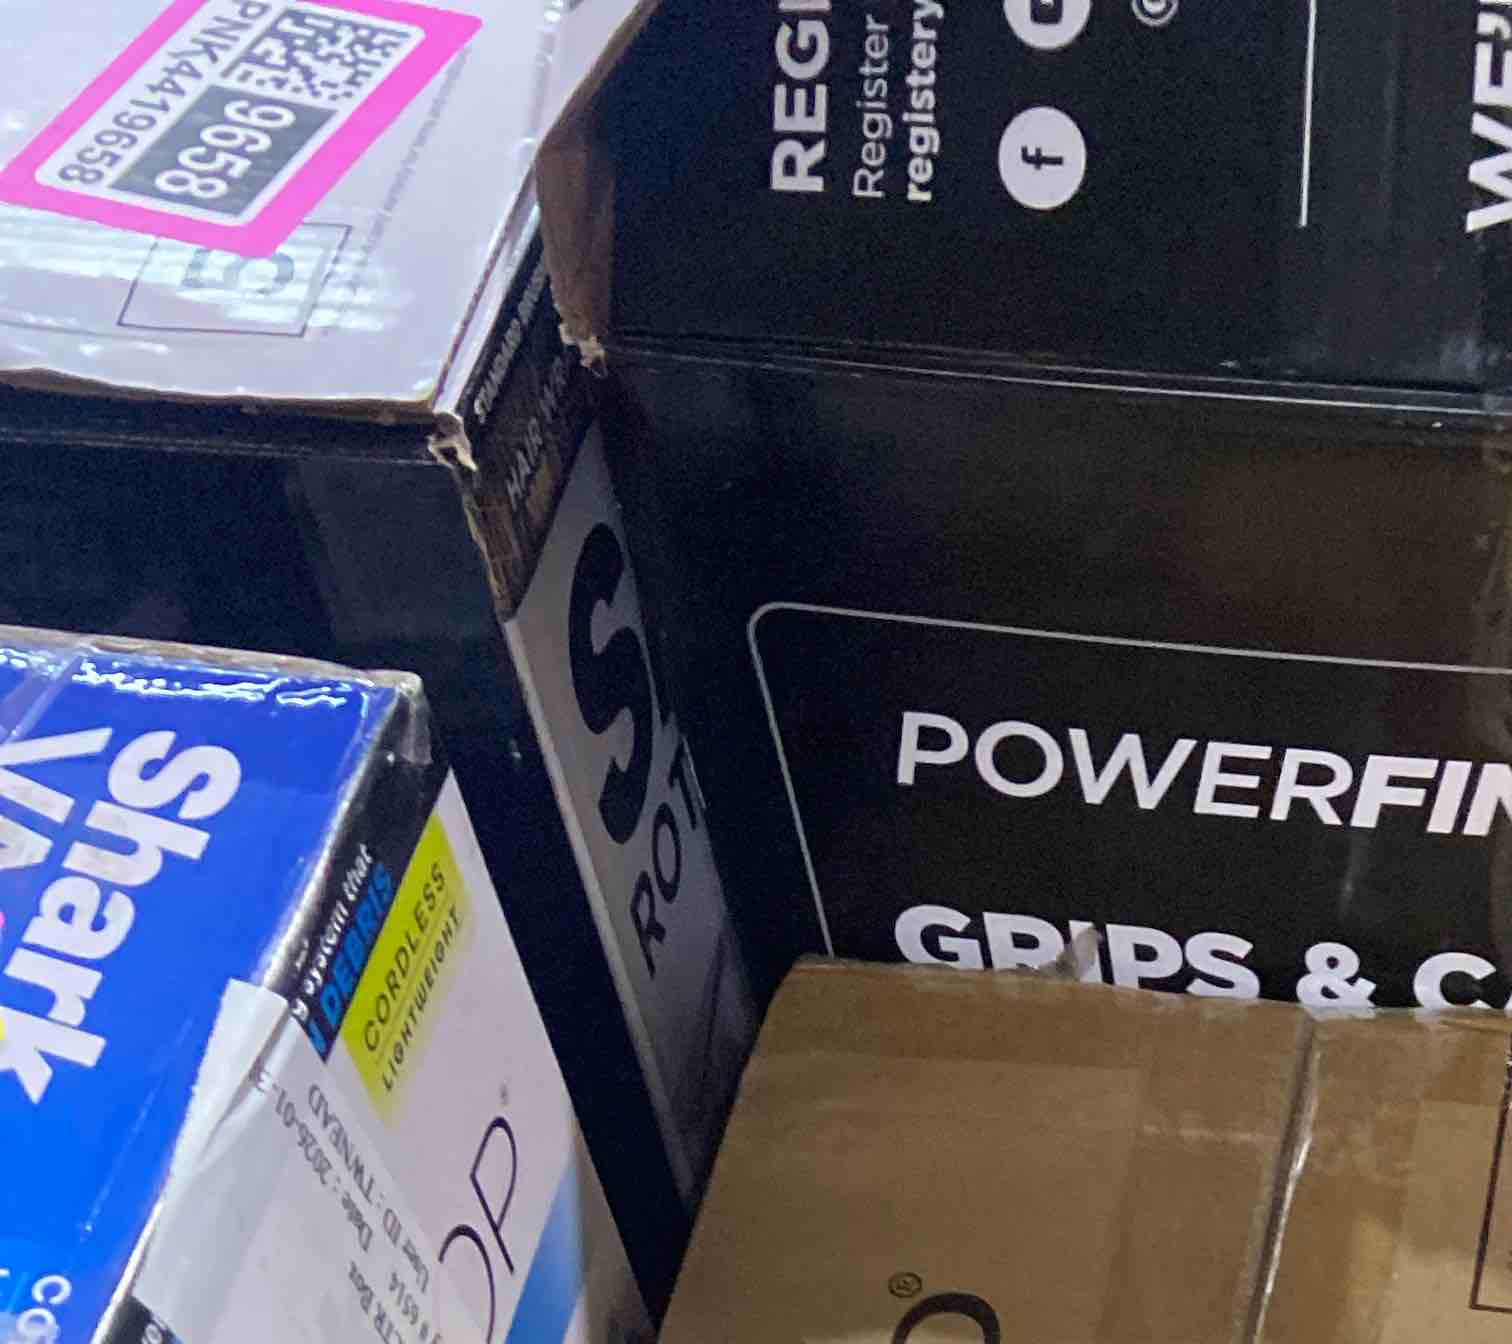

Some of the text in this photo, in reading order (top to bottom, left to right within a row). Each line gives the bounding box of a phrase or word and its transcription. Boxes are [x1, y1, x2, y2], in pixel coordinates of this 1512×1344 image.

[153, 98, 298, 200] 9658
[851, 13, 893, 199] Register
[0, 730, 242, 1104] Shark
[361, 860, 449, 1055] CORDLESS
[380, 907, 464, 1093] LIGHTWEIGHT
